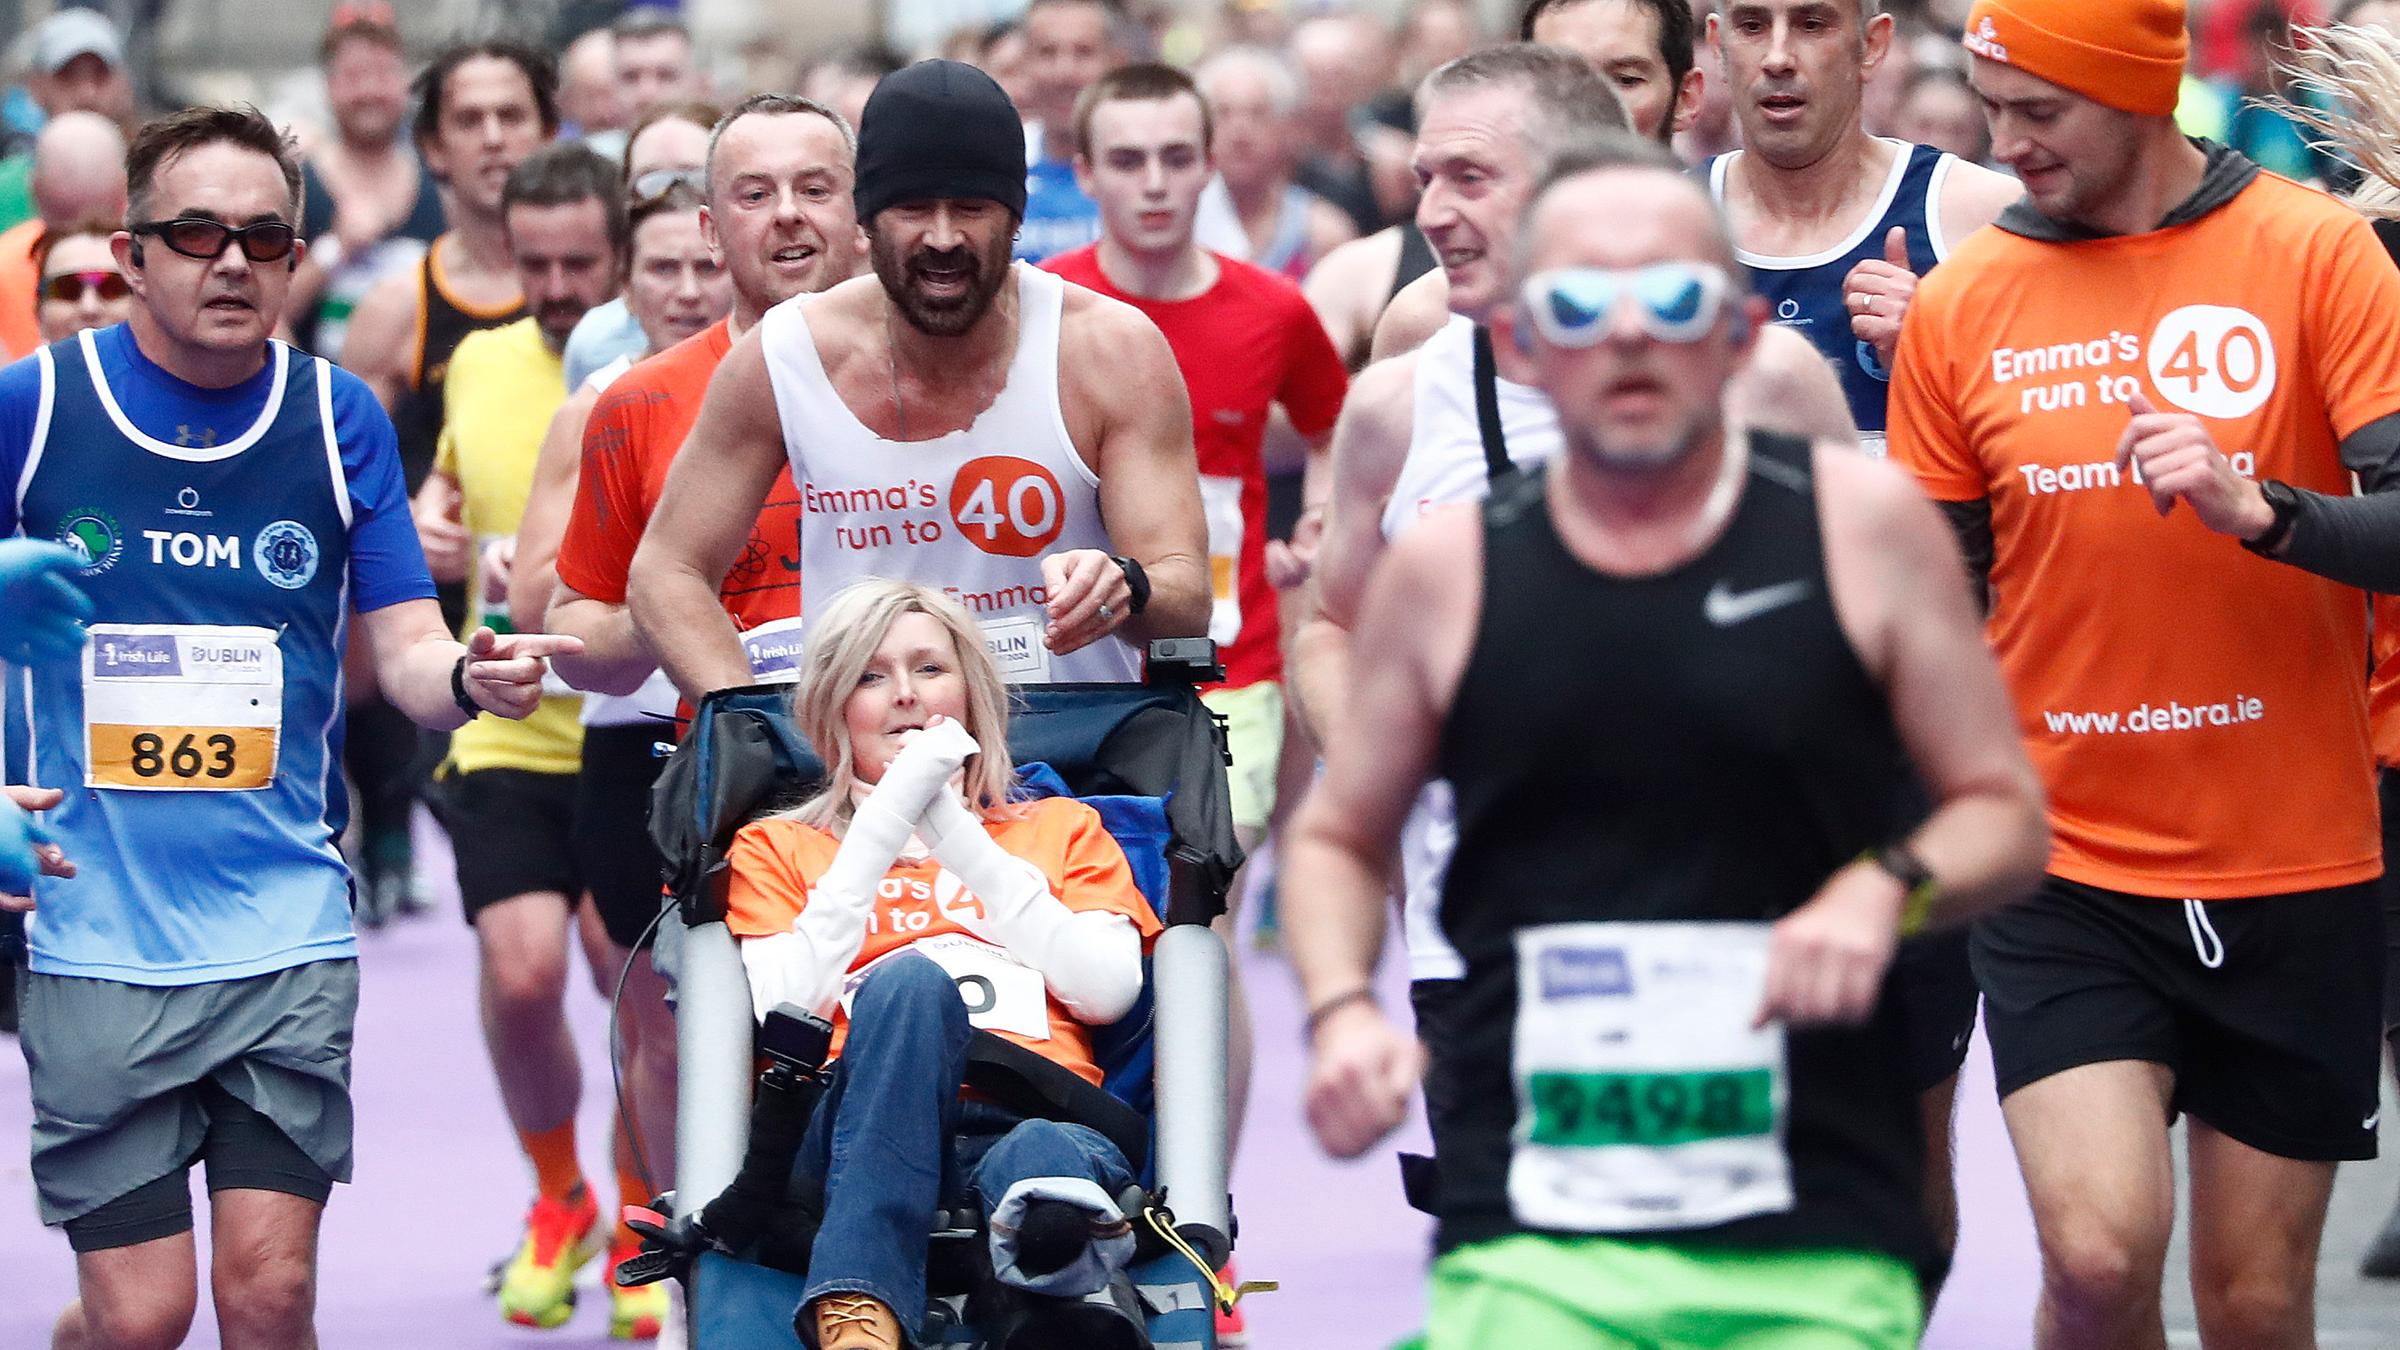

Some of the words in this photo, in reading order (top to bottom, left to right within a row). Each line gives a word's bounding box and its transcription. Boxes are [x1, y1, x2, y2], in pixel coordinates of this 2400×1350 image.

[1992, 330, 2140, 383] Emma's
[2160, 325, 2262, 394] 40
[2020, 381, 2086, 414] run
[2096, 374, 2140, 405] to
[2018, 460, 2121, 496] Team
[957, 475, 1057, 540] 40
[143, 529, 241, 569] TOM
[837, 521, 892, 550] run
[902, 519, 943, 545] to
[120, 650, 145, 663] Irish
[147, 650, 171, 664] Life
[192, 646, 261, 663] DUBLIN
[2043, 693, 2265, 734] www.debra.ie
[131, 732, 236, 779] 863
[889, 907, 930, 933] to
